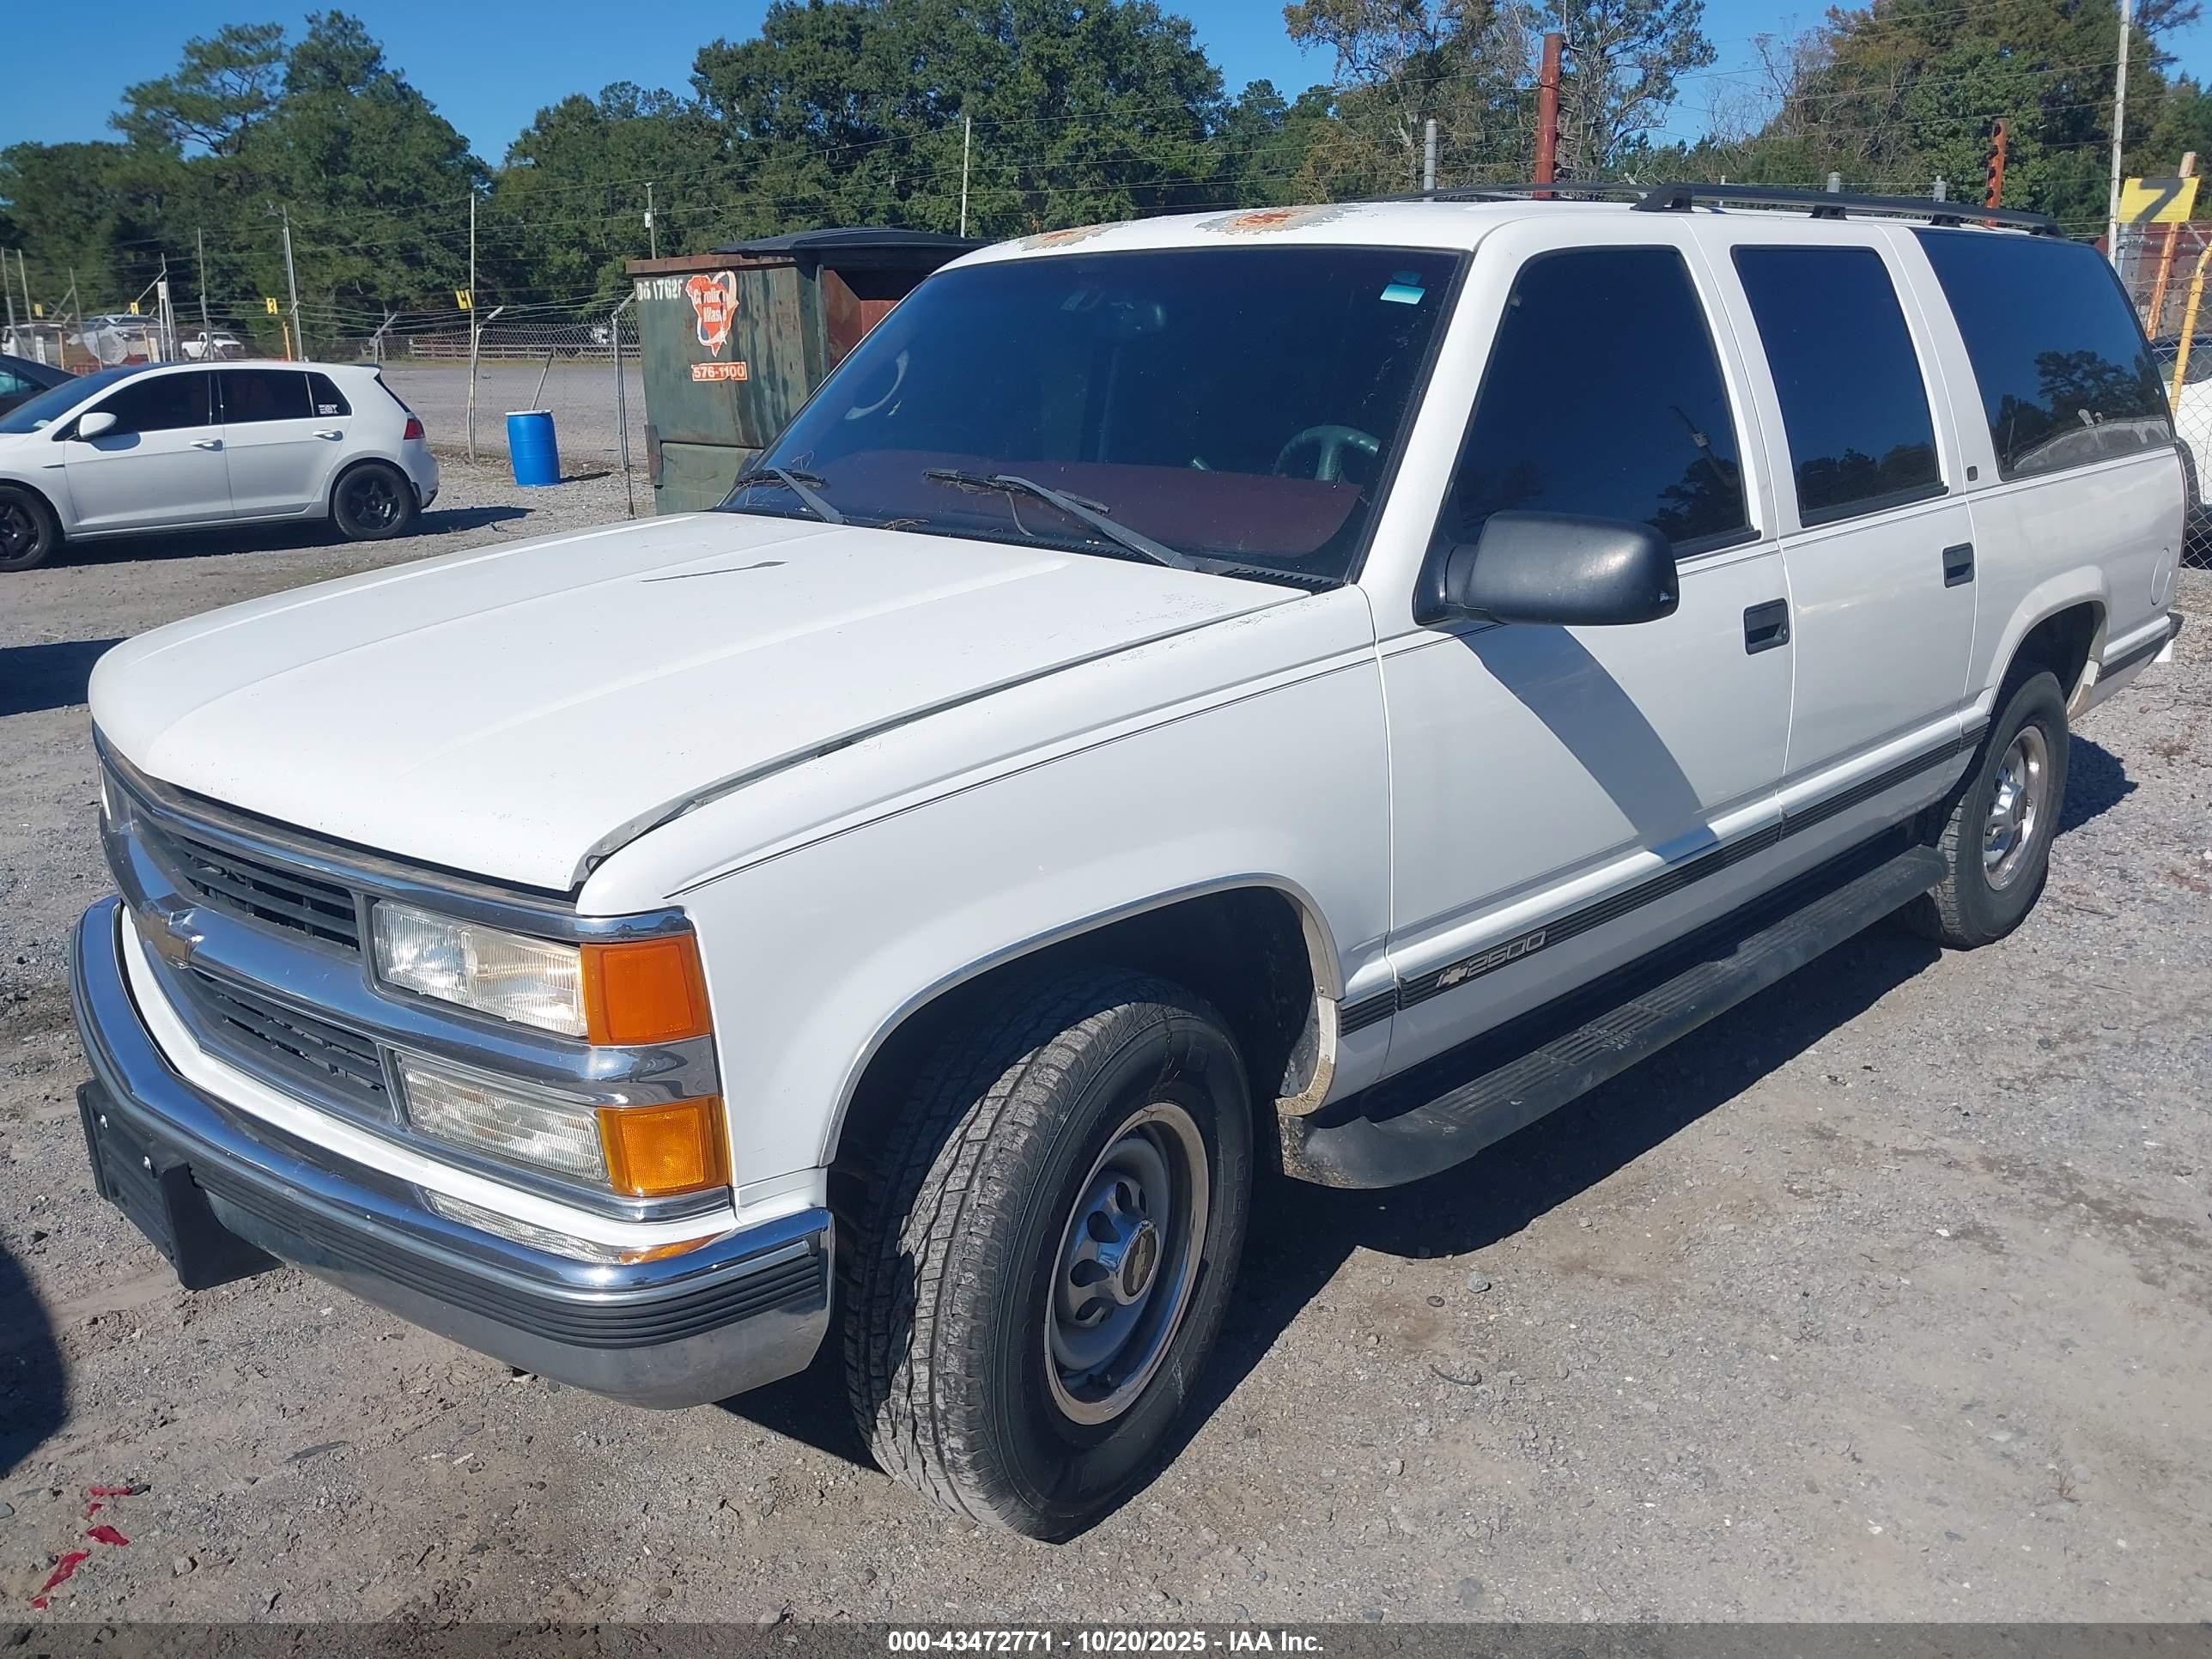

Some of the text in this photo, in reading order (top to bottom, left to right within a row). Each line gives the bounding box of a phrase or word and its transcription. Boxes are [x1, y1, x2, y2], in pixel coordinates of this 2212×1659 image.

[2132, 178, 2185, 223] 7
[693, 364, 745, 379] 576-1100
[1468, 930, 1546, 977] 2500
